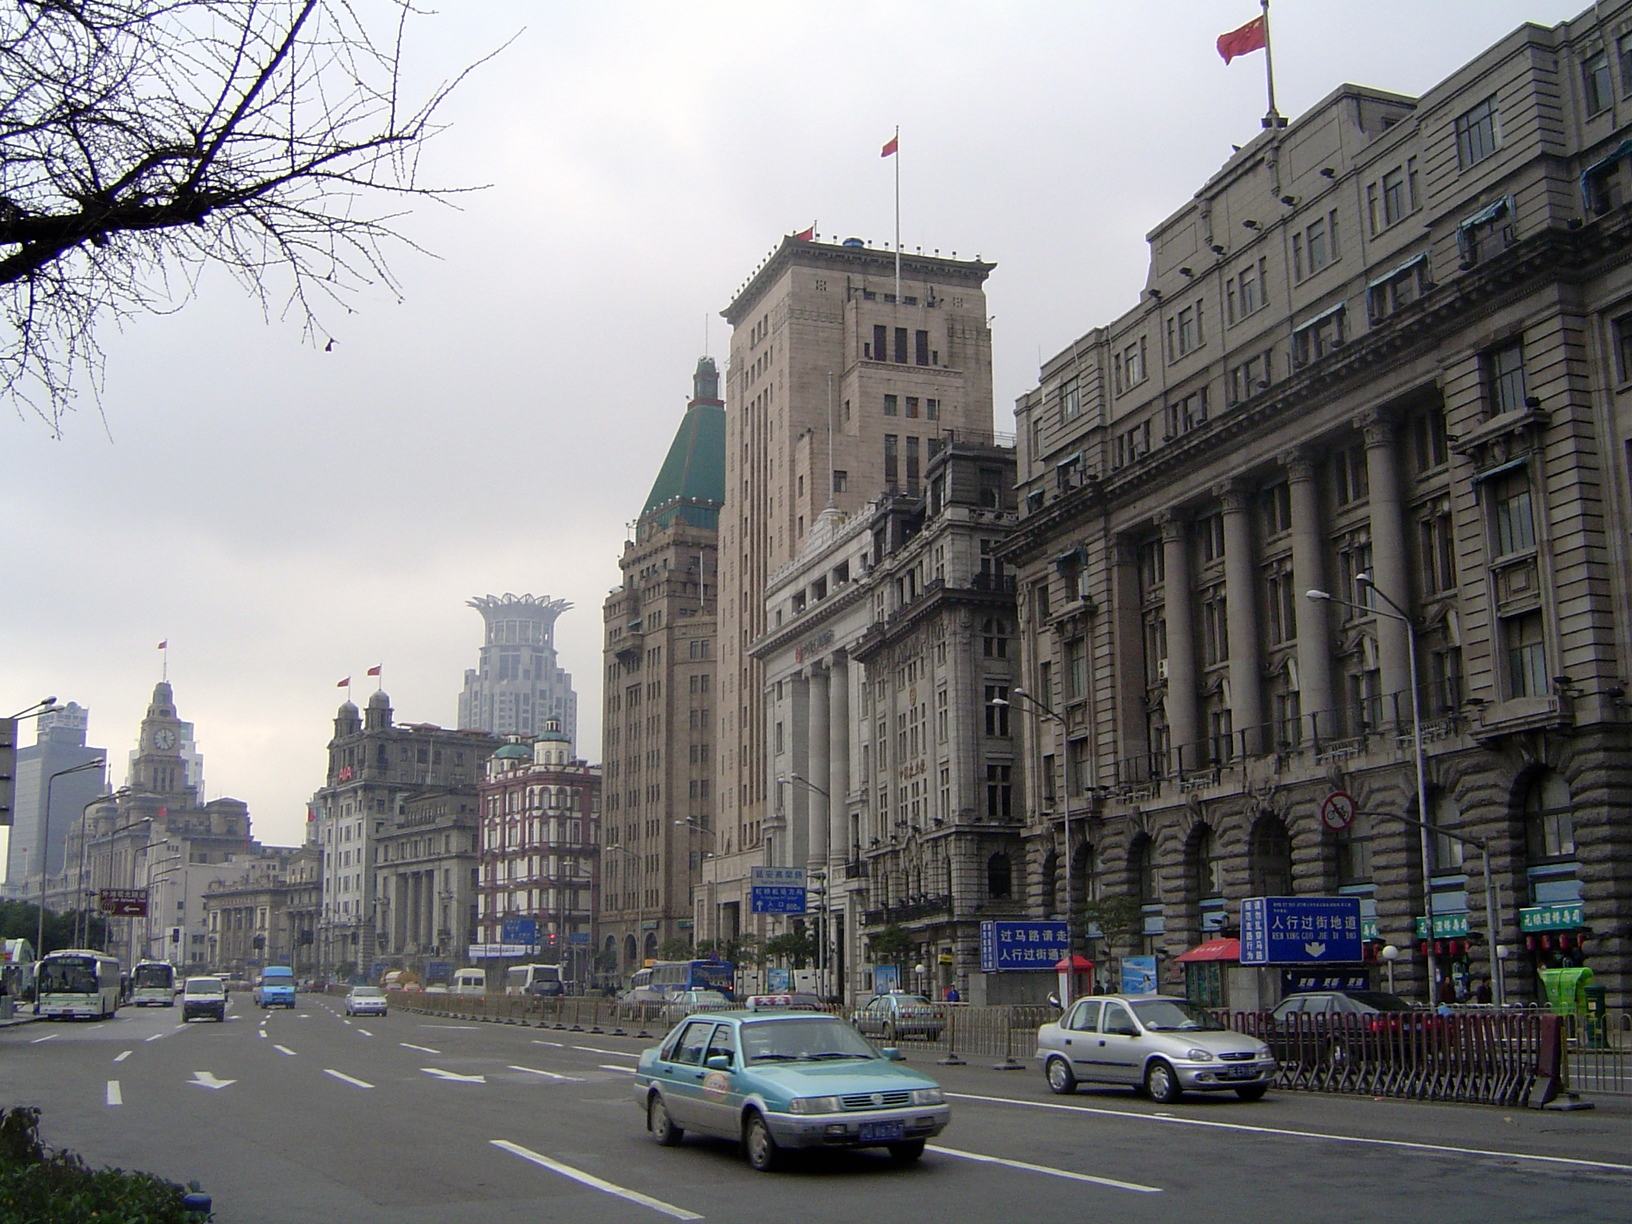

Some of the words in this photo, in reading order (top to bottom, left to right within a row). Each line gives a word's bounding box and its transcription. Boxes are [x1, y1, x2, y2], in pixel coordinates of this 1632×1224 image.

[338, 766, 352, 781] AIA
[1271, 915, 1357, 930] 人行过街地道
[1001, 929, 1068, 942] 过马路请走
